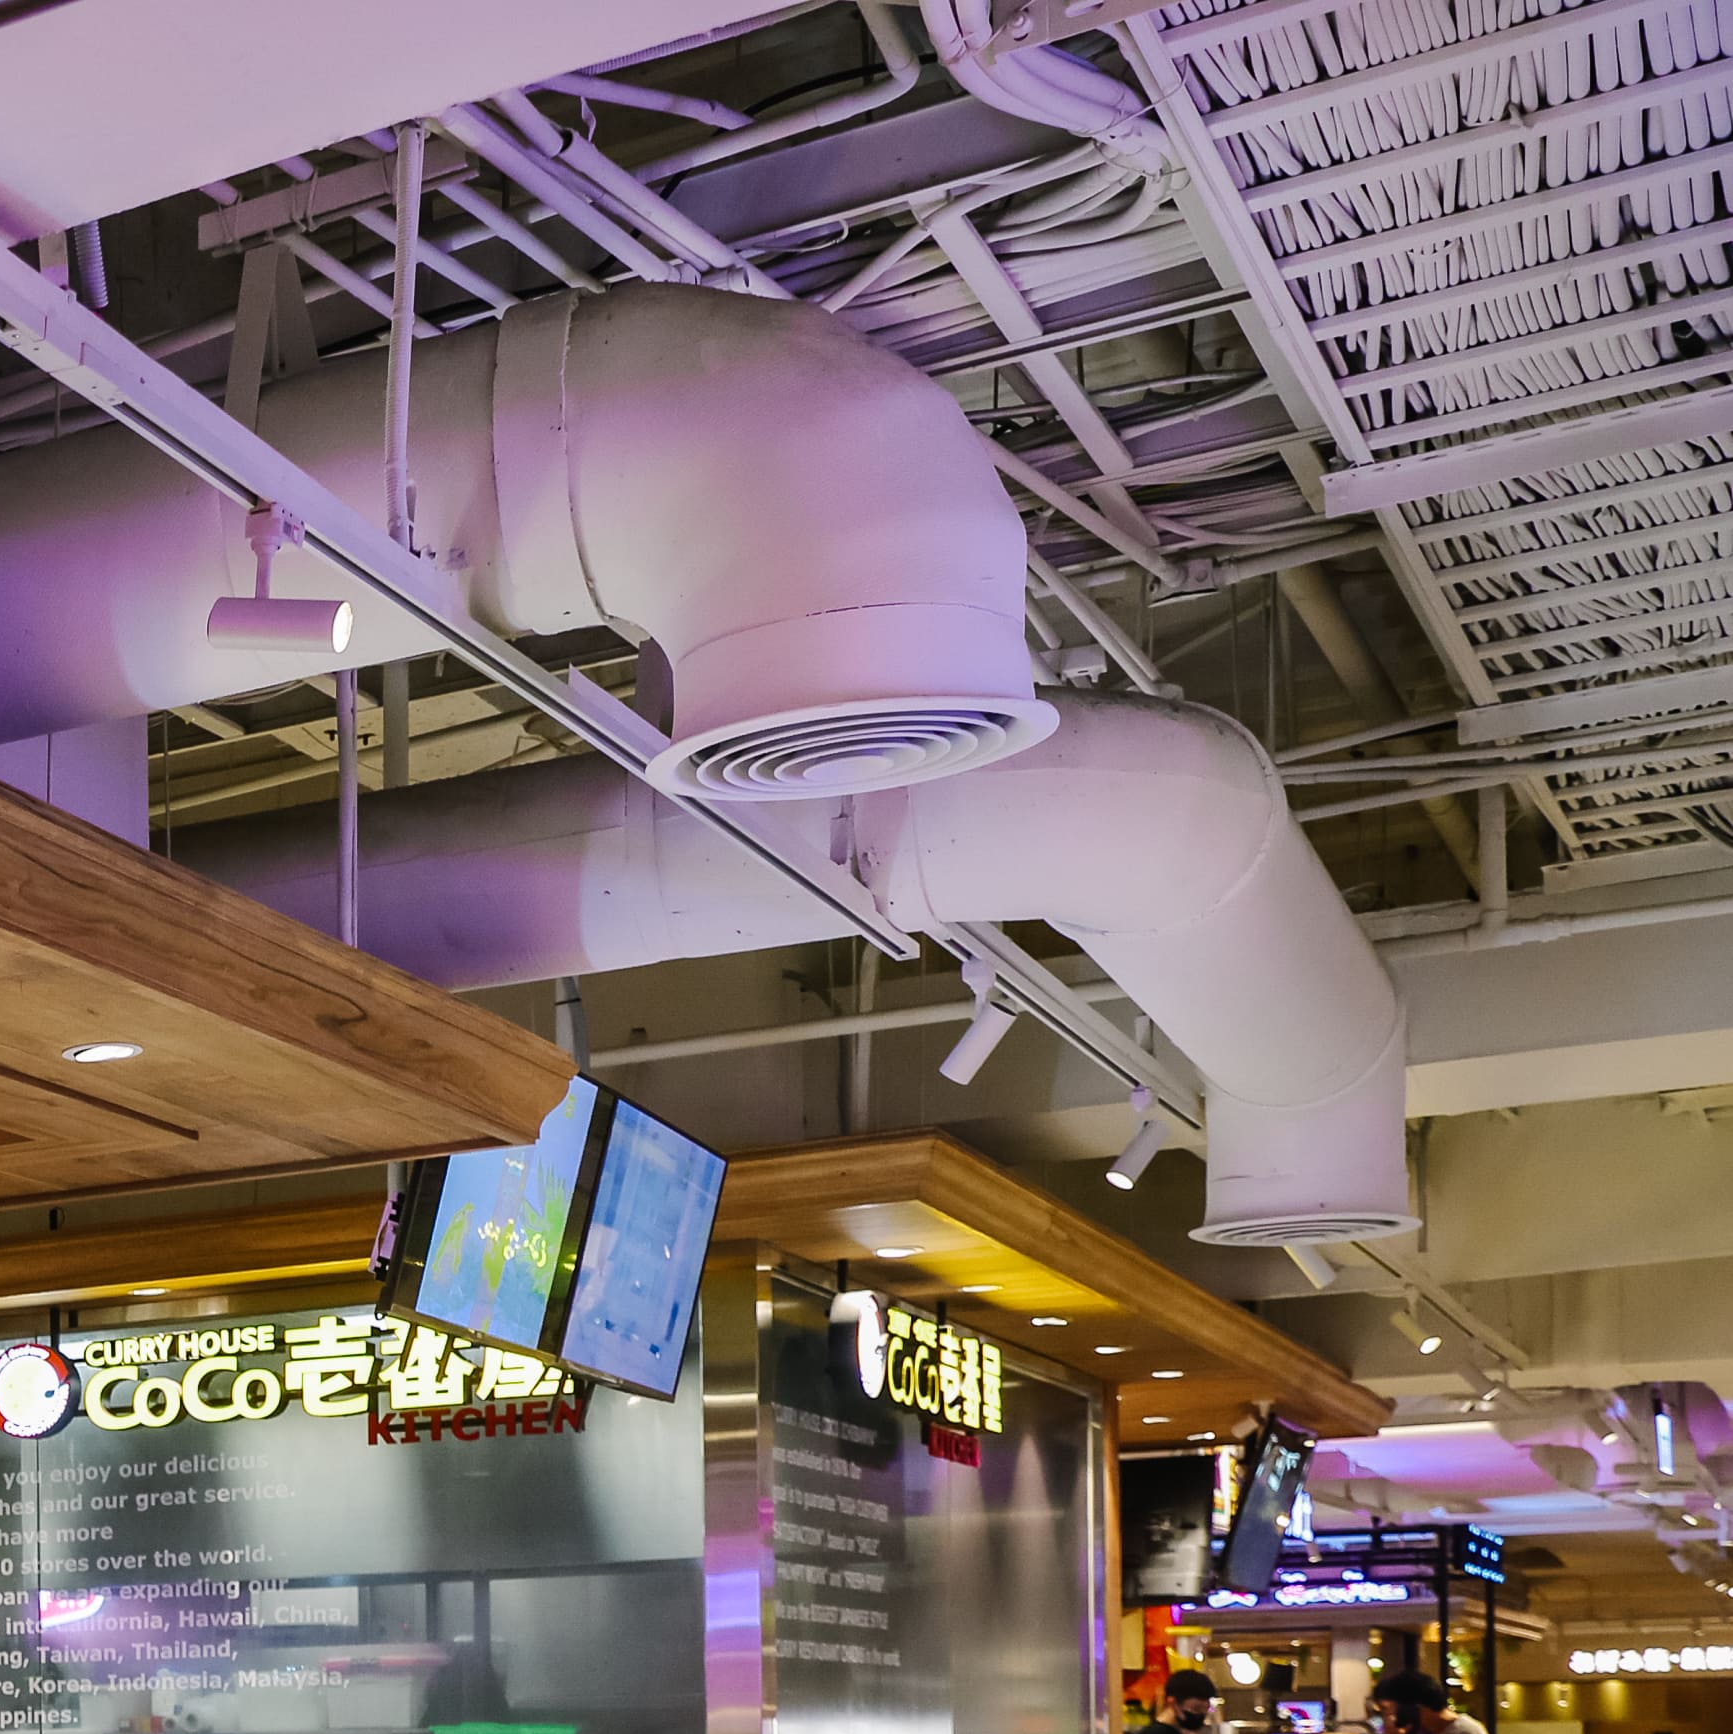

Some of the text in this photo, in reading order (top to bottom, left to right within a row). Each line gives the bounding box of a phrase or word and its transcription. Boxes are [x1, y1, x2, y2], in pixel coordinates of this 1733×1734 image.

[85, 1324, 275, 1367] CURRY HOUSE
[888, 1336, 940, 1414] CoCo
[85, 1355, 282, 1430] CoCo
[368, 1399, 584, 1445] KITCHEN
[4, 1470, 42, 1490] you
[50, 1463, 111, 1485] enjoy
[119, 1461, 157, 1478] our
[165, 1452, 270, 1475] delicious
[43, 1494, 83, 1513] and
[90, 1493, 128, 1510] our
[136, 1487, 197, 1512] great
[204, 1482, 295, 1503] service.
[56, 1526, 114, 1542] more
[21, 1556, 89, 1575] stores
[96, 1554, 147, 1571] over
[154, 1549, 191, 1567] the
[199, 1545, 273, 1565] world.
[120, 1578, 240, 1601] expanding
[248, 1578, 289, 1594] our
[179, 1608, 265, 1629] Hawaii,
[274, 1605, 349, 1625] China,
[37, 1644, 124, 1665] Taiwan,
[132, 1639, 239, 1661] Thailand,
[28, 1675, 99, 1696] Korea,
[107, 1671, 229, 1692] Indonesia,
[238, 1669, 350, 1691] Malaysia,
